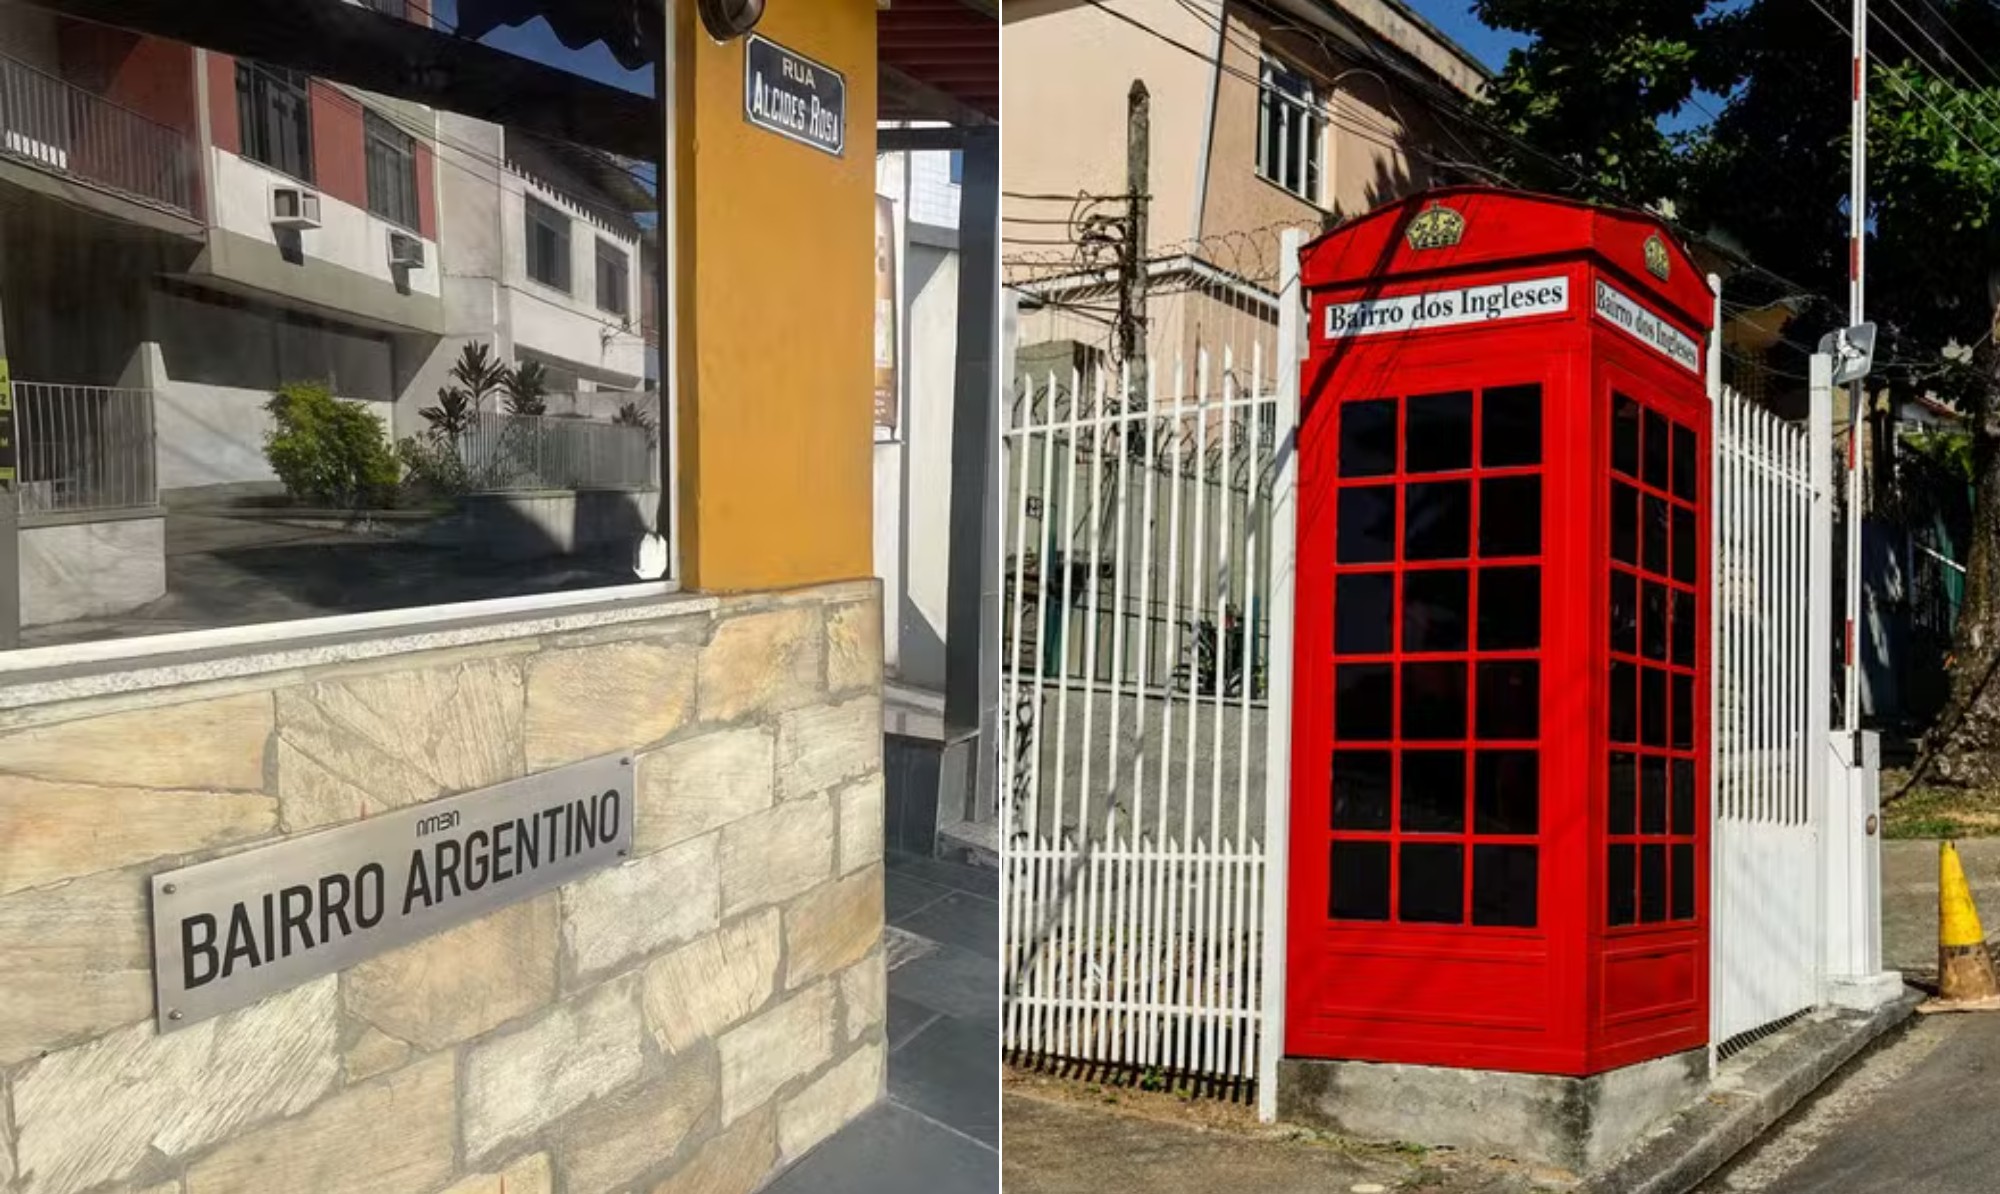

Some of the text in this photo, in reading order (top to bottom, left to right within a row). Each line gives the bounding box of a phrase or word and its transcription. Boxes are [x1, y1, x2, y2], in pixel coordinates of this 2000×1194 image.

[782, 57, 816, 89] RUA
[753, 71, 839, 143] ALCIDES ROSA
[1330, 283, 1563, 332] Bairro dos Ingleses
[1597, 284, 1633, 328] Bairro
[1635, 308, 1656, 342] dos
[181, 788, 620, 990] BAIRRO ARGENTINO
